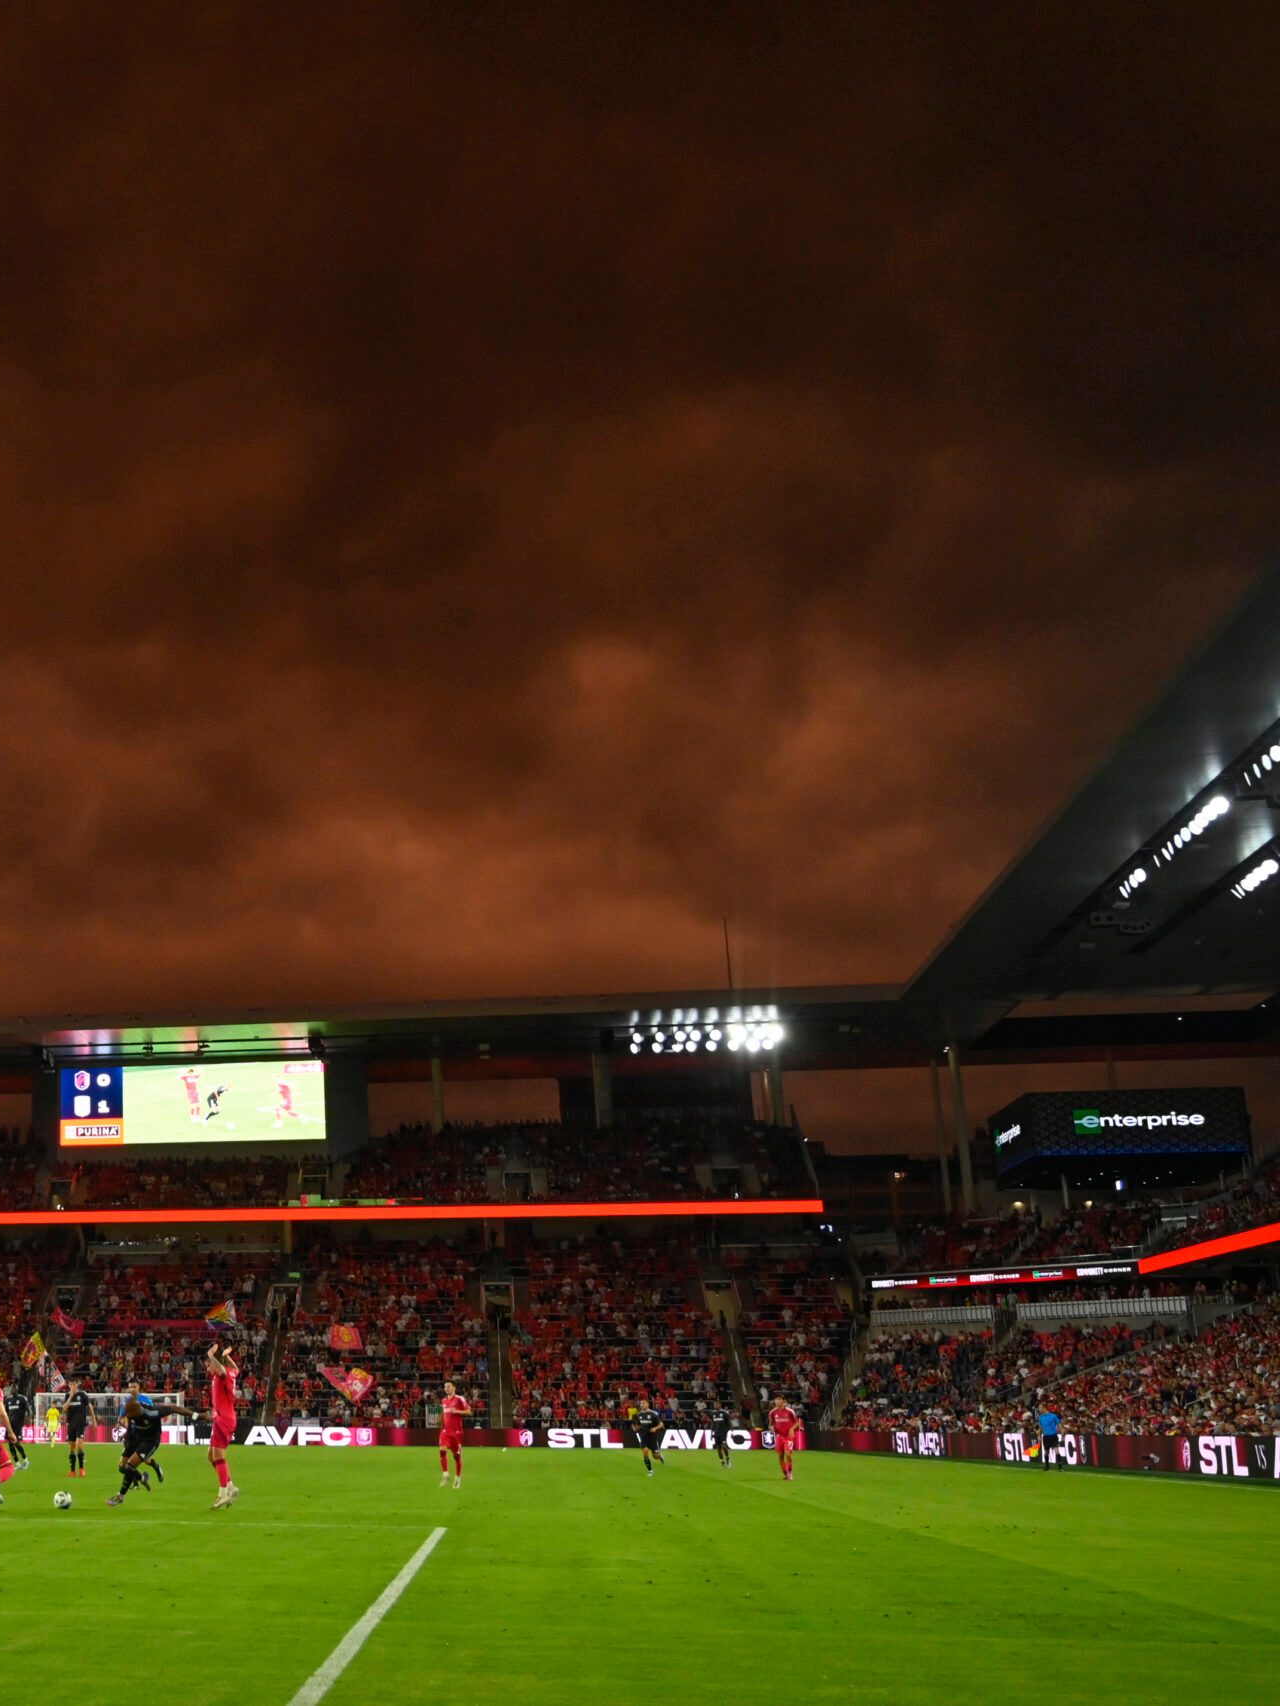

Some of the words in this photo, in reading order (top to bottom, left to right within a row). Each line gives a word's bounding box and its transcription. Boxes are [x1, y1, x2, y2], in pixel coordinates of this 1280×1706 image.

[78, 1126, 118, 1136] PURINA
[1073, 1111, 1205, 1130] enterprise
[995, 1124, 1021, 1147] enterprise
[244, 1426, 352, 1446] AVFC
[547, 1428, 624, 1449] STL
[895, 1432, 913, 1455] STL
[1003, 1433, 1031, 1463] STL
[1198, 1436, 1250, 1477] STL
[1254, 1444, 1267, 1470] VS
